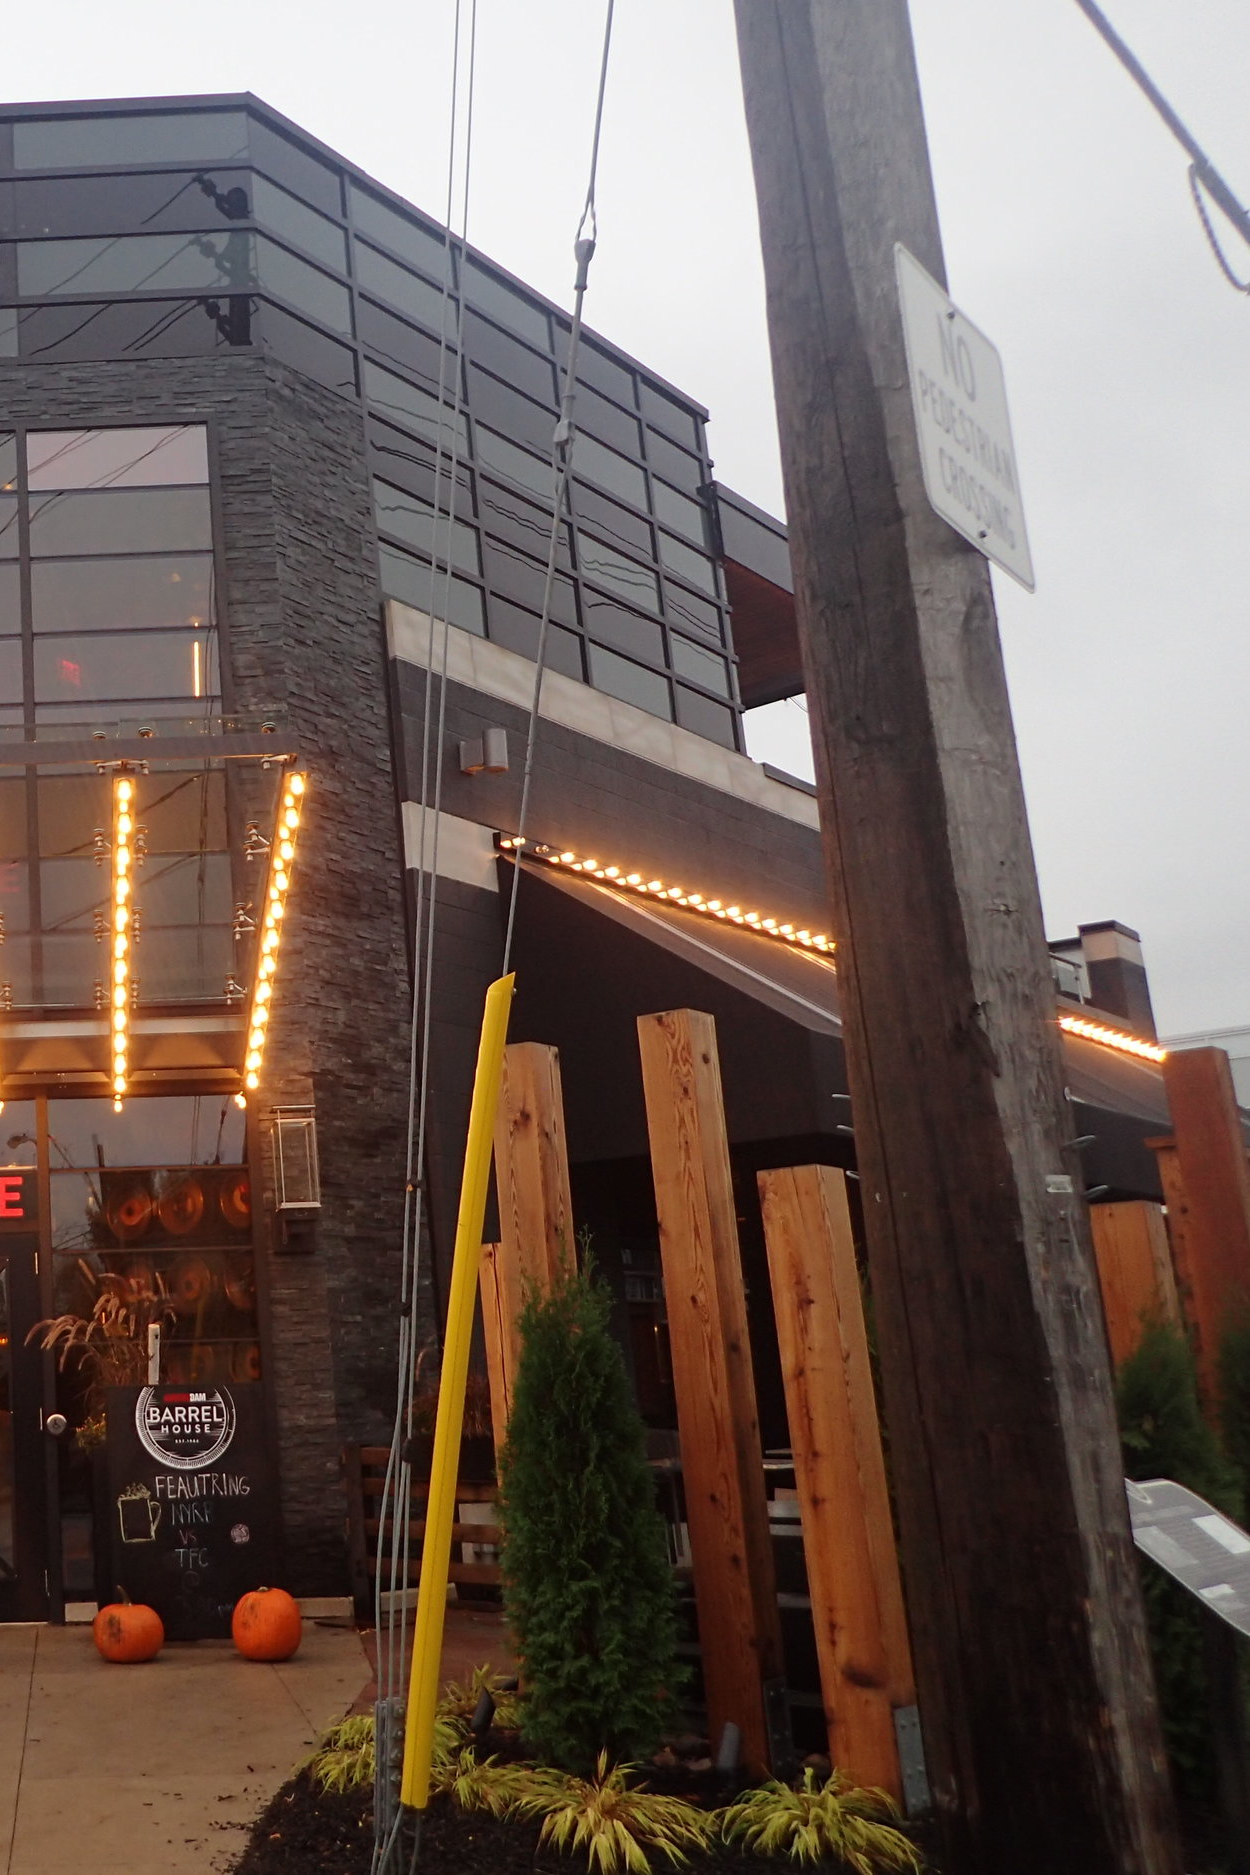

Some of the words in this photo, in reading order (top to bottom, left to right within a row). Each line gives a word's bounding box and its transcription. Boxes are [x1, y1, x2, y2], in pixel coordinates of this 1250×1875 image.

[936, 312, 976, 403] NO
[918, 368, 1015, 496] PEDESTRIAN
[939, 446, 1017, 550] CROSSING
[149, 1405, 223, 1424] BARREL
[161, 1423, 211, 1434] HOUSE
[155, 1473, 251, 1499] FEAUTRING
[174, 1548, 209, 1569] TFC
